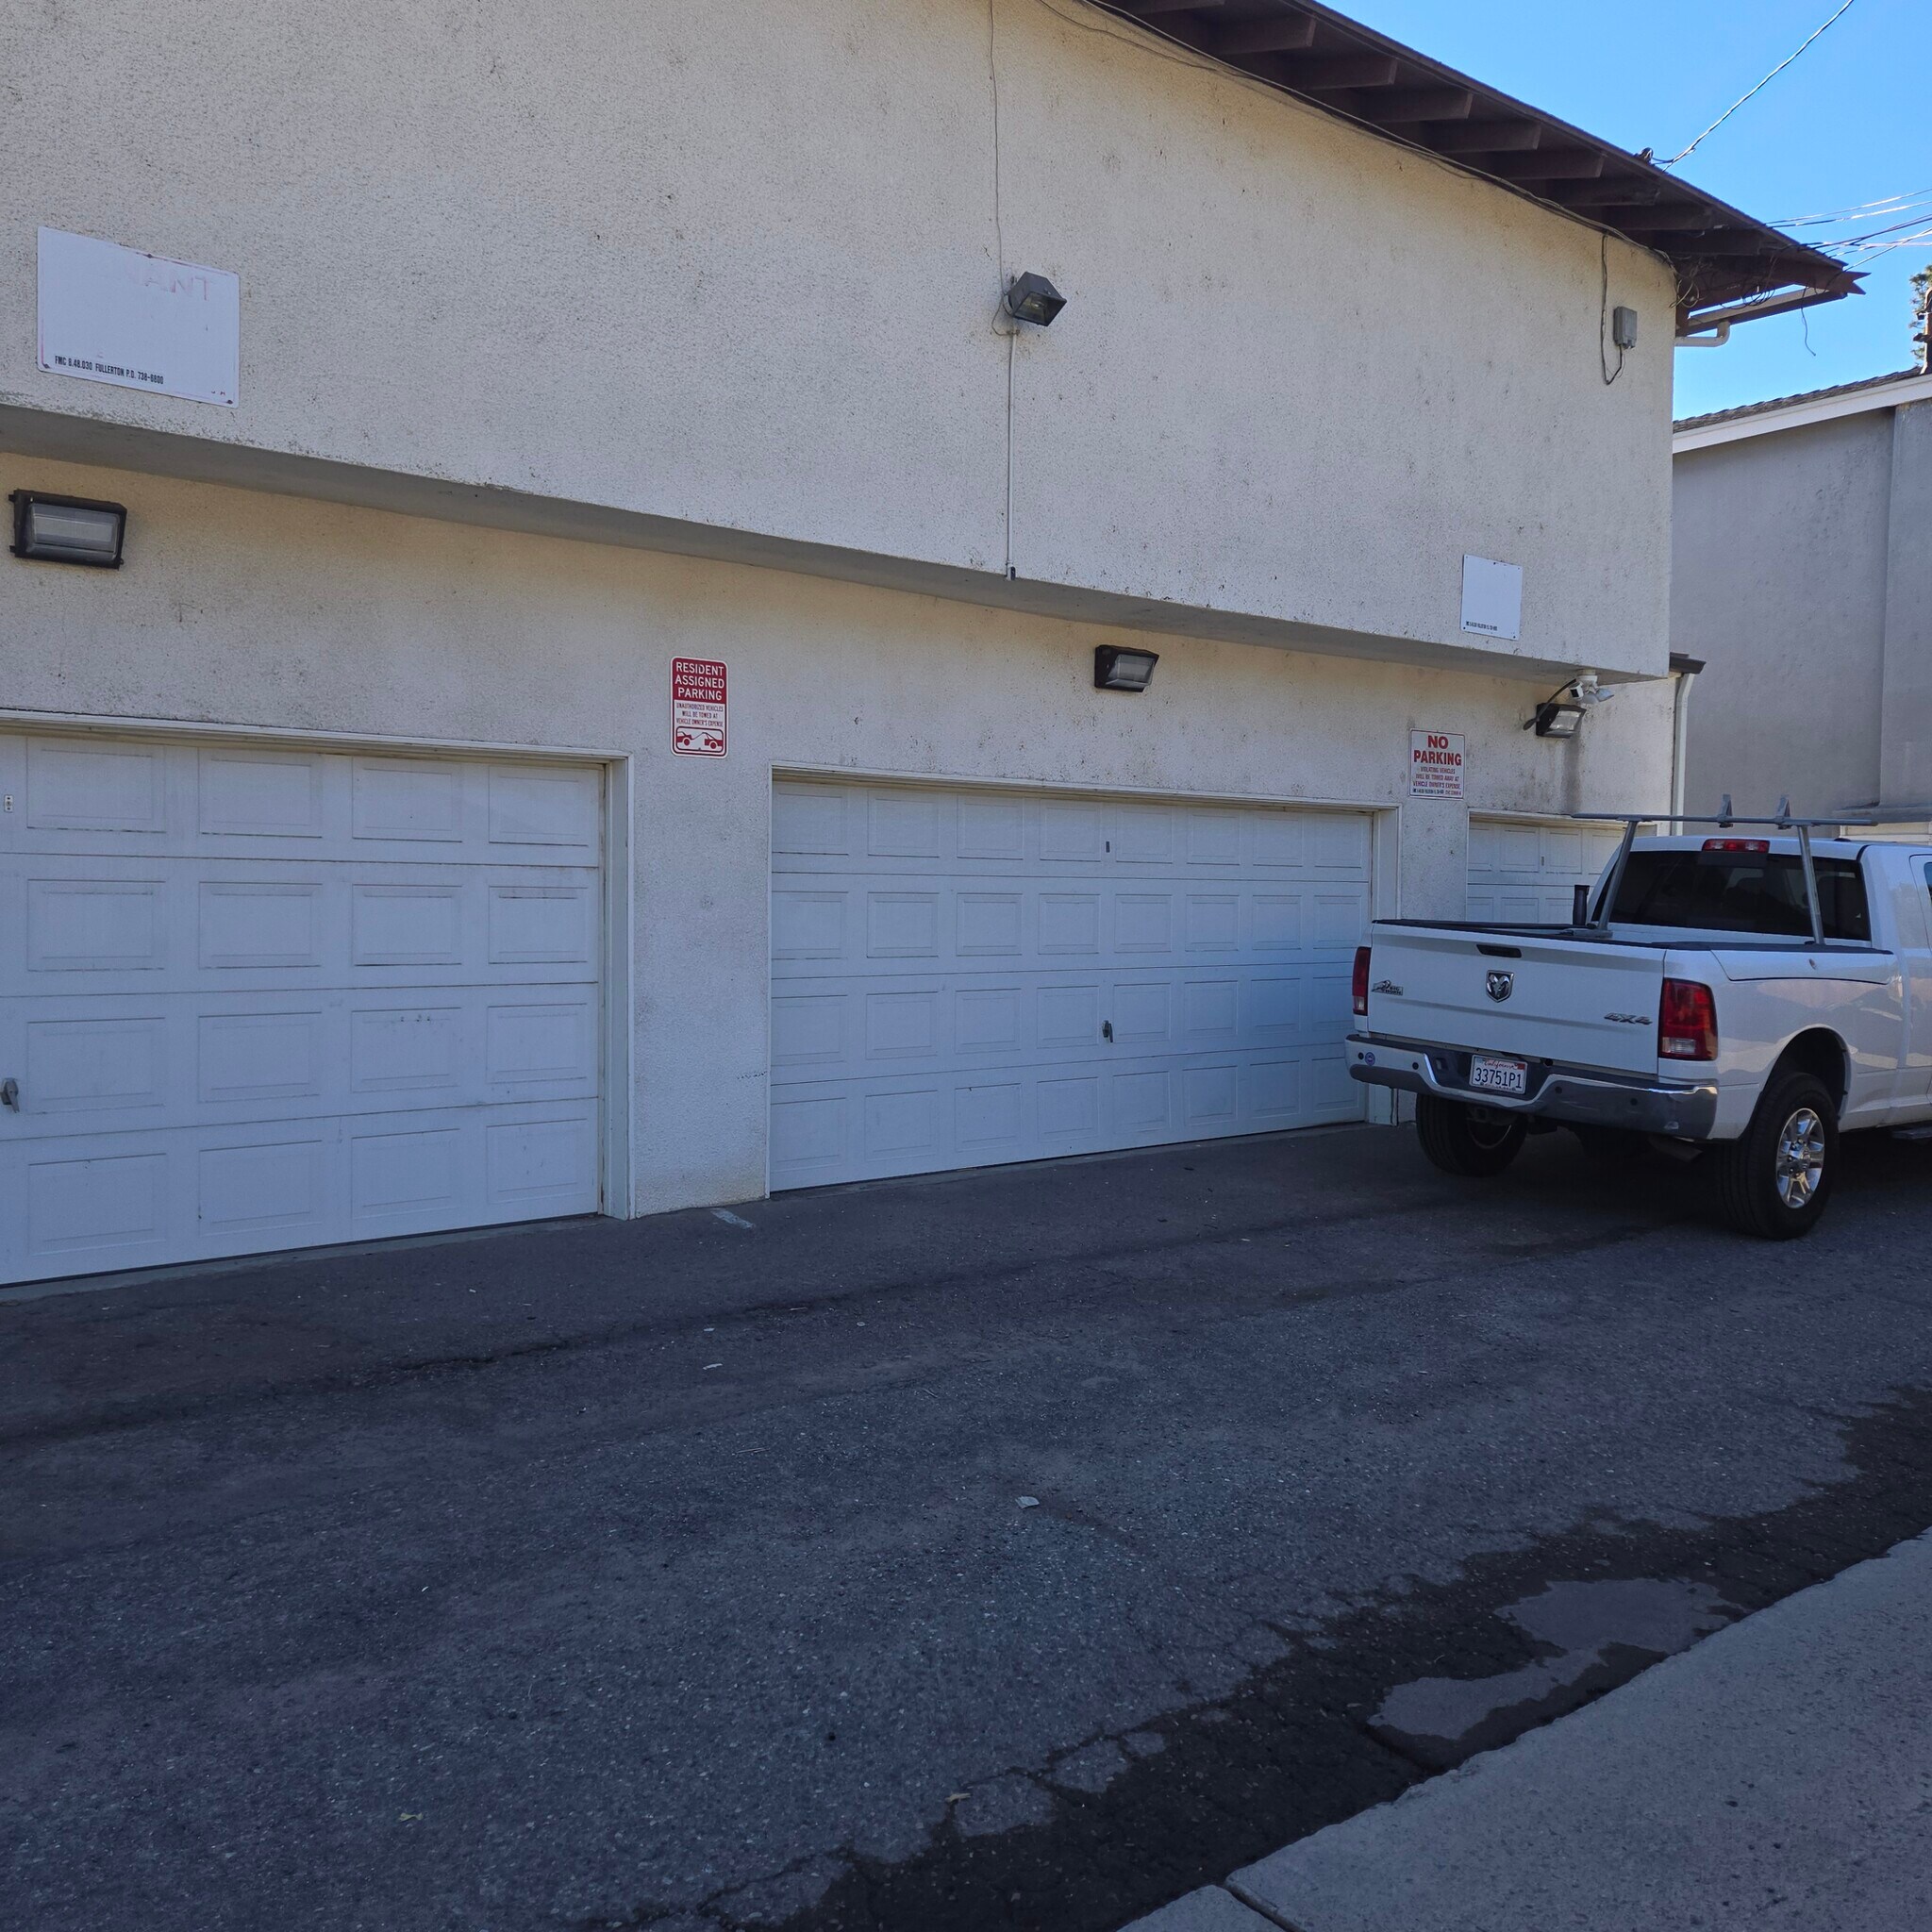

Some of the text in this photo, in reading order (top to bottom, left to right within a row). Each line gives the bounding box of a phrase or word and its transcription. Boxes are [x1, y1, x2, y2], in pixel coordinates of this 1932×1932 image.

[55, 356, 67, 366] FMC
[95, 363, 125, 376] FULLERTON
[125, 369, 137, 379] P.D.
[138, 371, 164, 385] 738-6800
[675, 661, 724, 676] RESIDENT
[675, 675, 724, 689] ASSIGNED
[677, 687, 723, 700] PARKING
[1427, 735, 1449, 750] NO
[1413, 749, 1462, 766] PARKING
[1483, 1058, 1518, 1070] California
[1474, 1067, 1522, 1089] 33751P1
